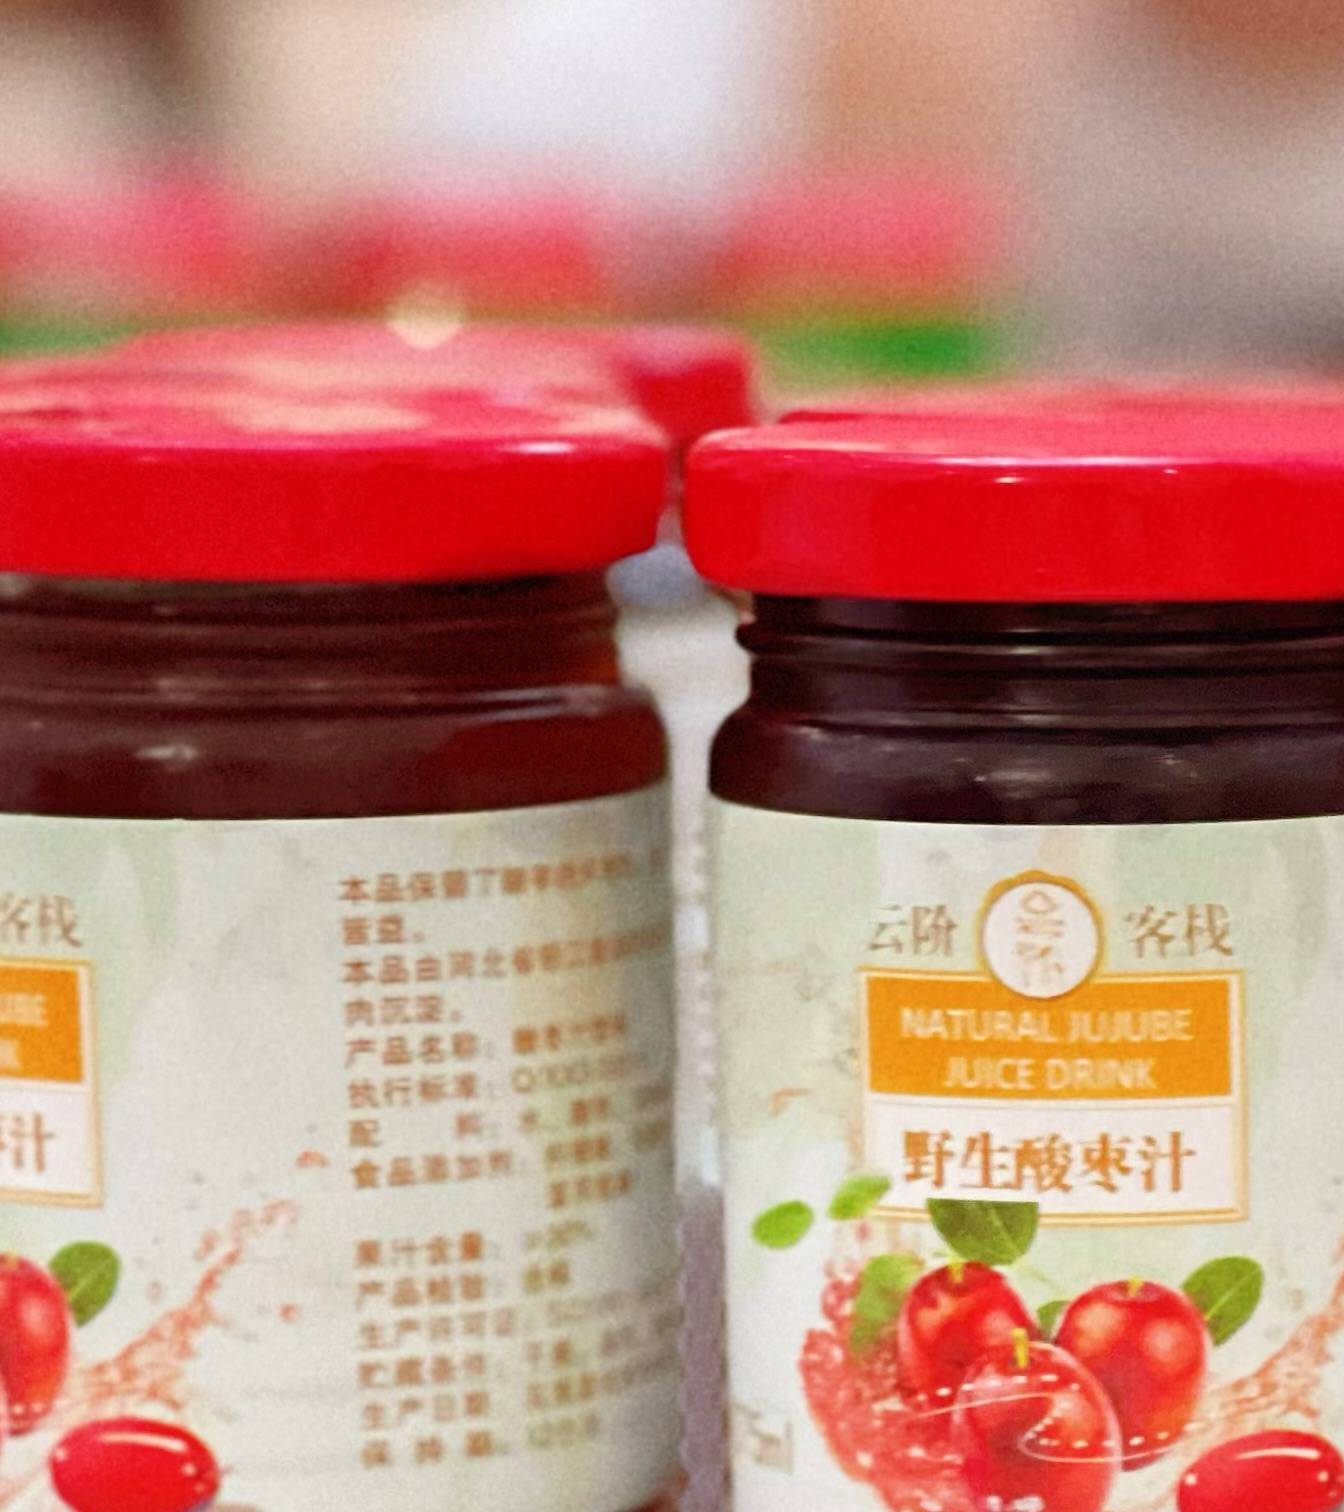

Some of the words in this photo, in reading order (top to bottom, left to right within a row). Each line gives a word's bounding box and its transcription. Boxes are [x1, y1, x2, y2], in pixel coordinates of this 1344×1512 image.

[867, 903, 959, 958] 云阶
[1126, 903, 1234, 959] 客栈
[900, 1008, 1059, 1044] NATURAL
[1067, 1008, 1195, 1043] JUJUBE
[944, 1056, 1036, 1091] JUICE
[1044, 1057, 1159, 1091] DRINK
[903, 1129, 1198, 1195] 野生酸枣汁
